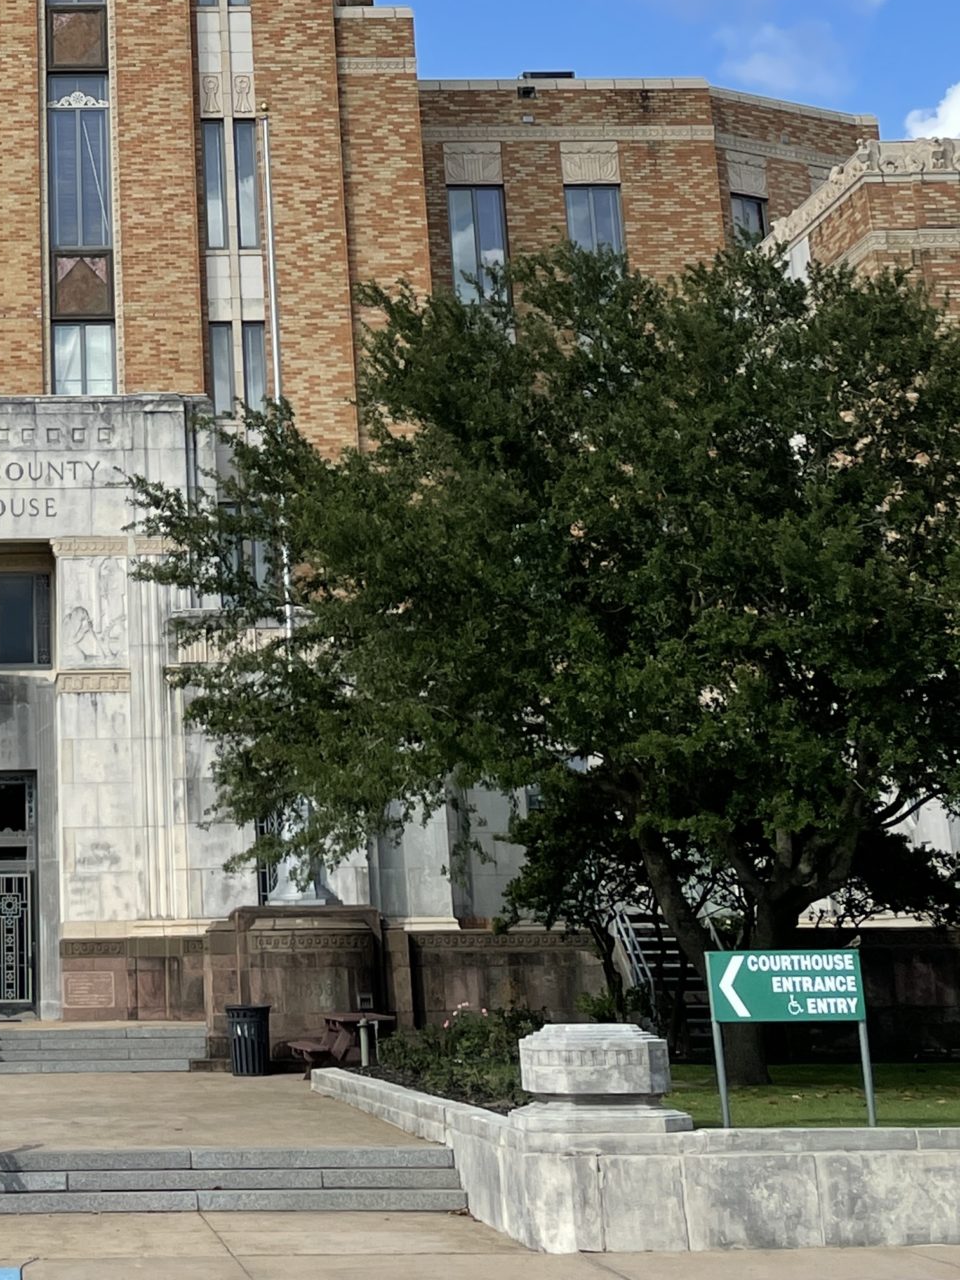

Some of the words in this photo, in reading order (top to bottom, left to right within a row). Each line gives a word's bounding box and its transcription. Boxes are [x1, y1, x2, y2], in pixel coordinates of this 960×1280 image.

[747, 955, 854, 971] COURTHOUSE
[772, 976, 857, 992] ENTRANCE
[807, 998, 858, 1013] ENTRY
